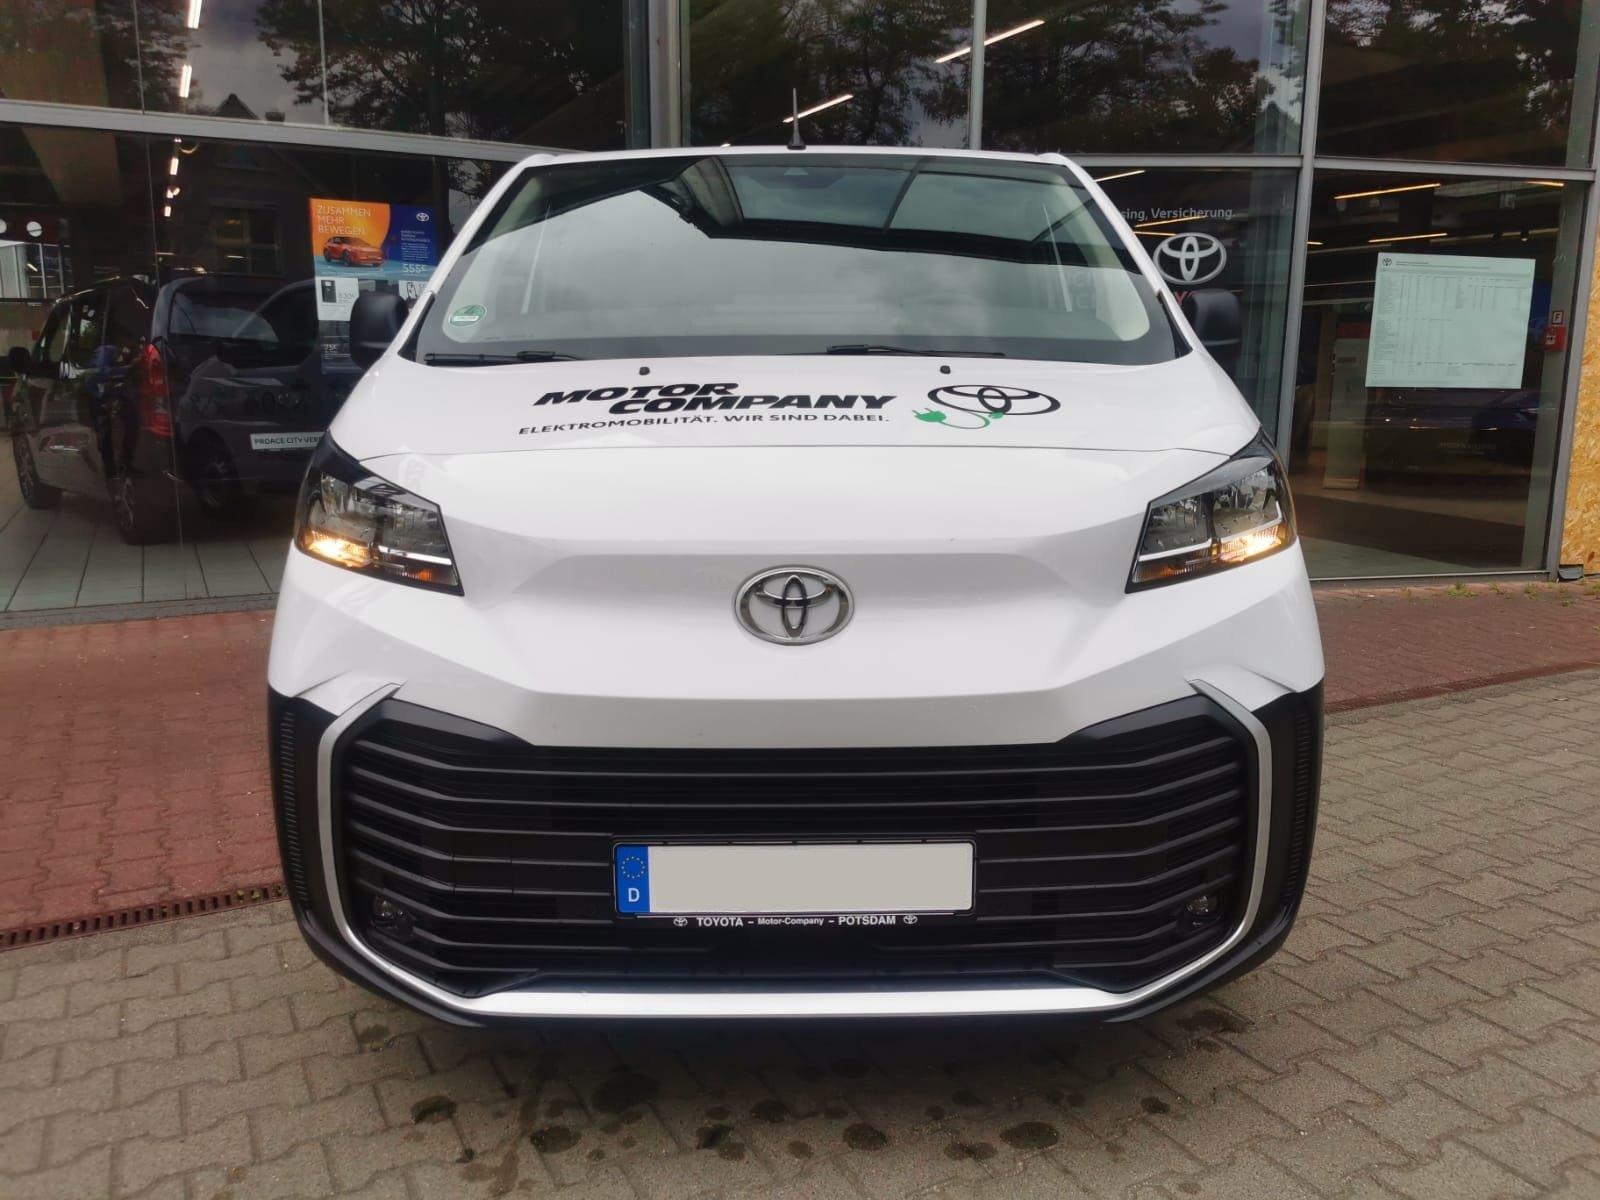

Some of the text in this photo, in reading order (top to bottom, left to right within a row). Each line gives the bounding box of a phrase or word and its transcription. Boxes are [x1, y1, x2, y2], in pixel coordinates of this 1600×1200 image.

[317, 204, 371, 217] ZUSAMMEN
[1121, 207, 1233, 221] sing, Versicherung
[317, 215, 345, 225] MEHR
[318, 223, 366, 236] BEWEGEN
[532, 382, 739, 406] MOTOR
[608, 395, 898, 415] COMPANY
[518, 414, 890, 435] ELEKTROMOBILITÄT. WIR SIND DABEI.
[254, 437, 285, 445] PROACE
[286, 437, 302, 445] CITY
[627, 887, 641, 903] D
[696, 916, 744, 927] TOYOTA
[757, 916, 825, 926] Motor-Company
[838, 914, 897, 926] POTSDAM
